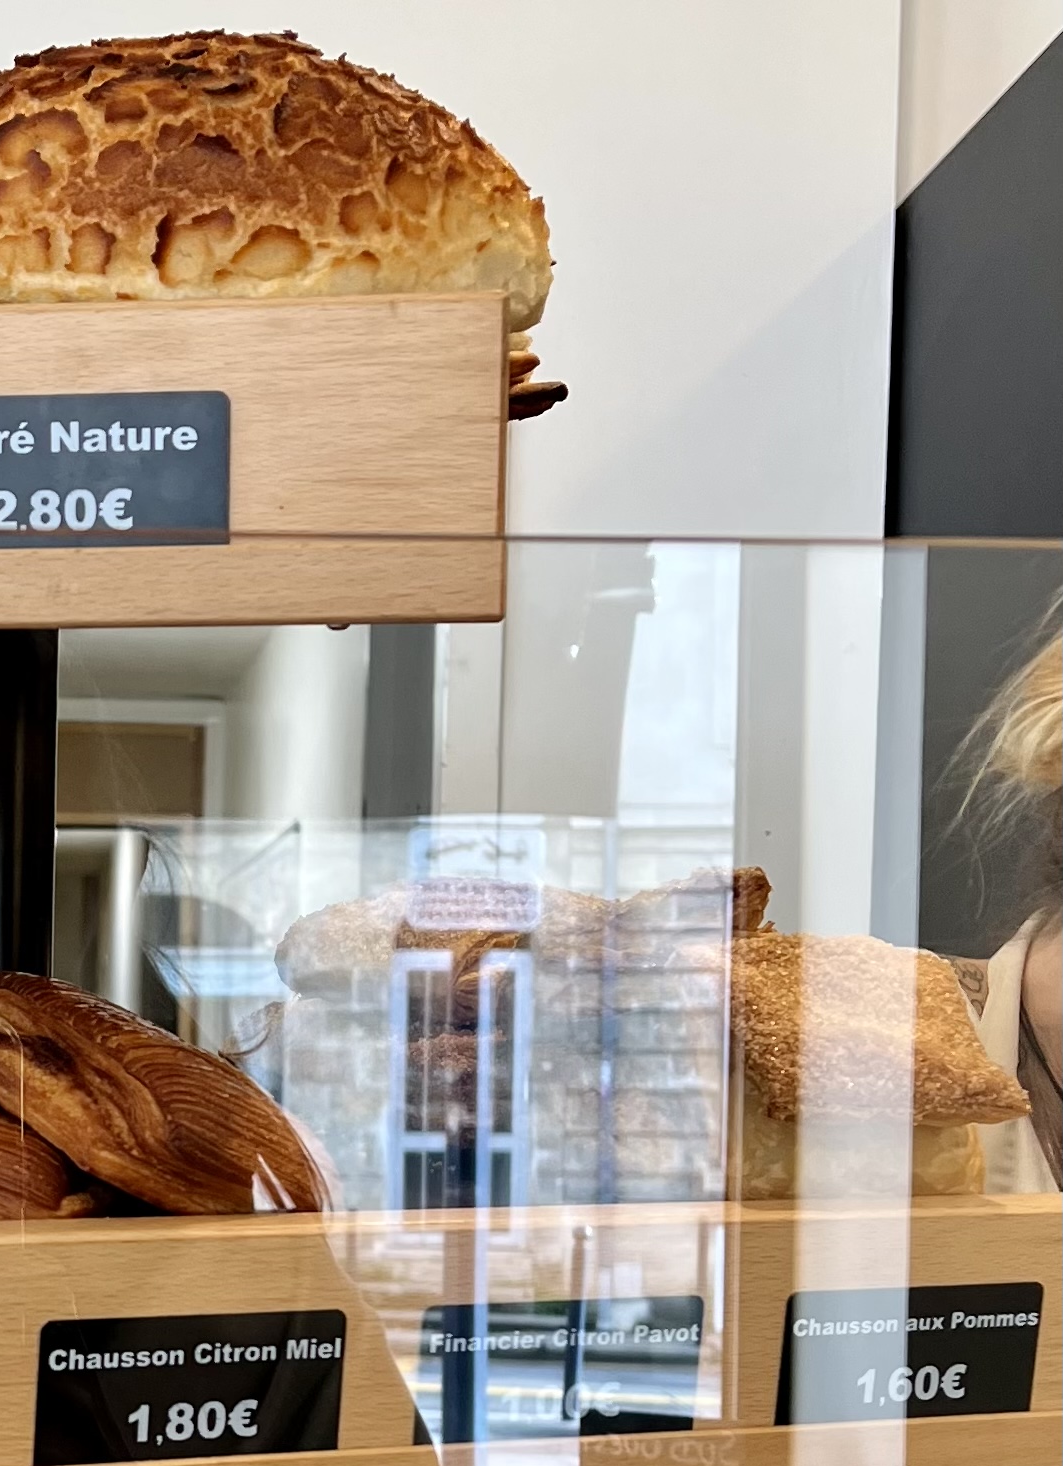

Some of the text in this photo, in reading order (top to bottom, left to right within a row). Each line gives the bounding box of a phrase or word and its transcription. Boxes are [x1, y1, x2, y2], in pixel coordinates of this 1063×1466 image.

[50, 421, 198, 453] Nature
[429, 1323, 700, 1354] Financier Citron Pavot
[793, 1309, 1040, 1338] Chausson aux Pommes
[48, 1337, 342, 1372] Chausson Citron Miel
[855, 1363, 968, 1410] 1,60€
[127, 1398, 259, 1446] 1,80€
